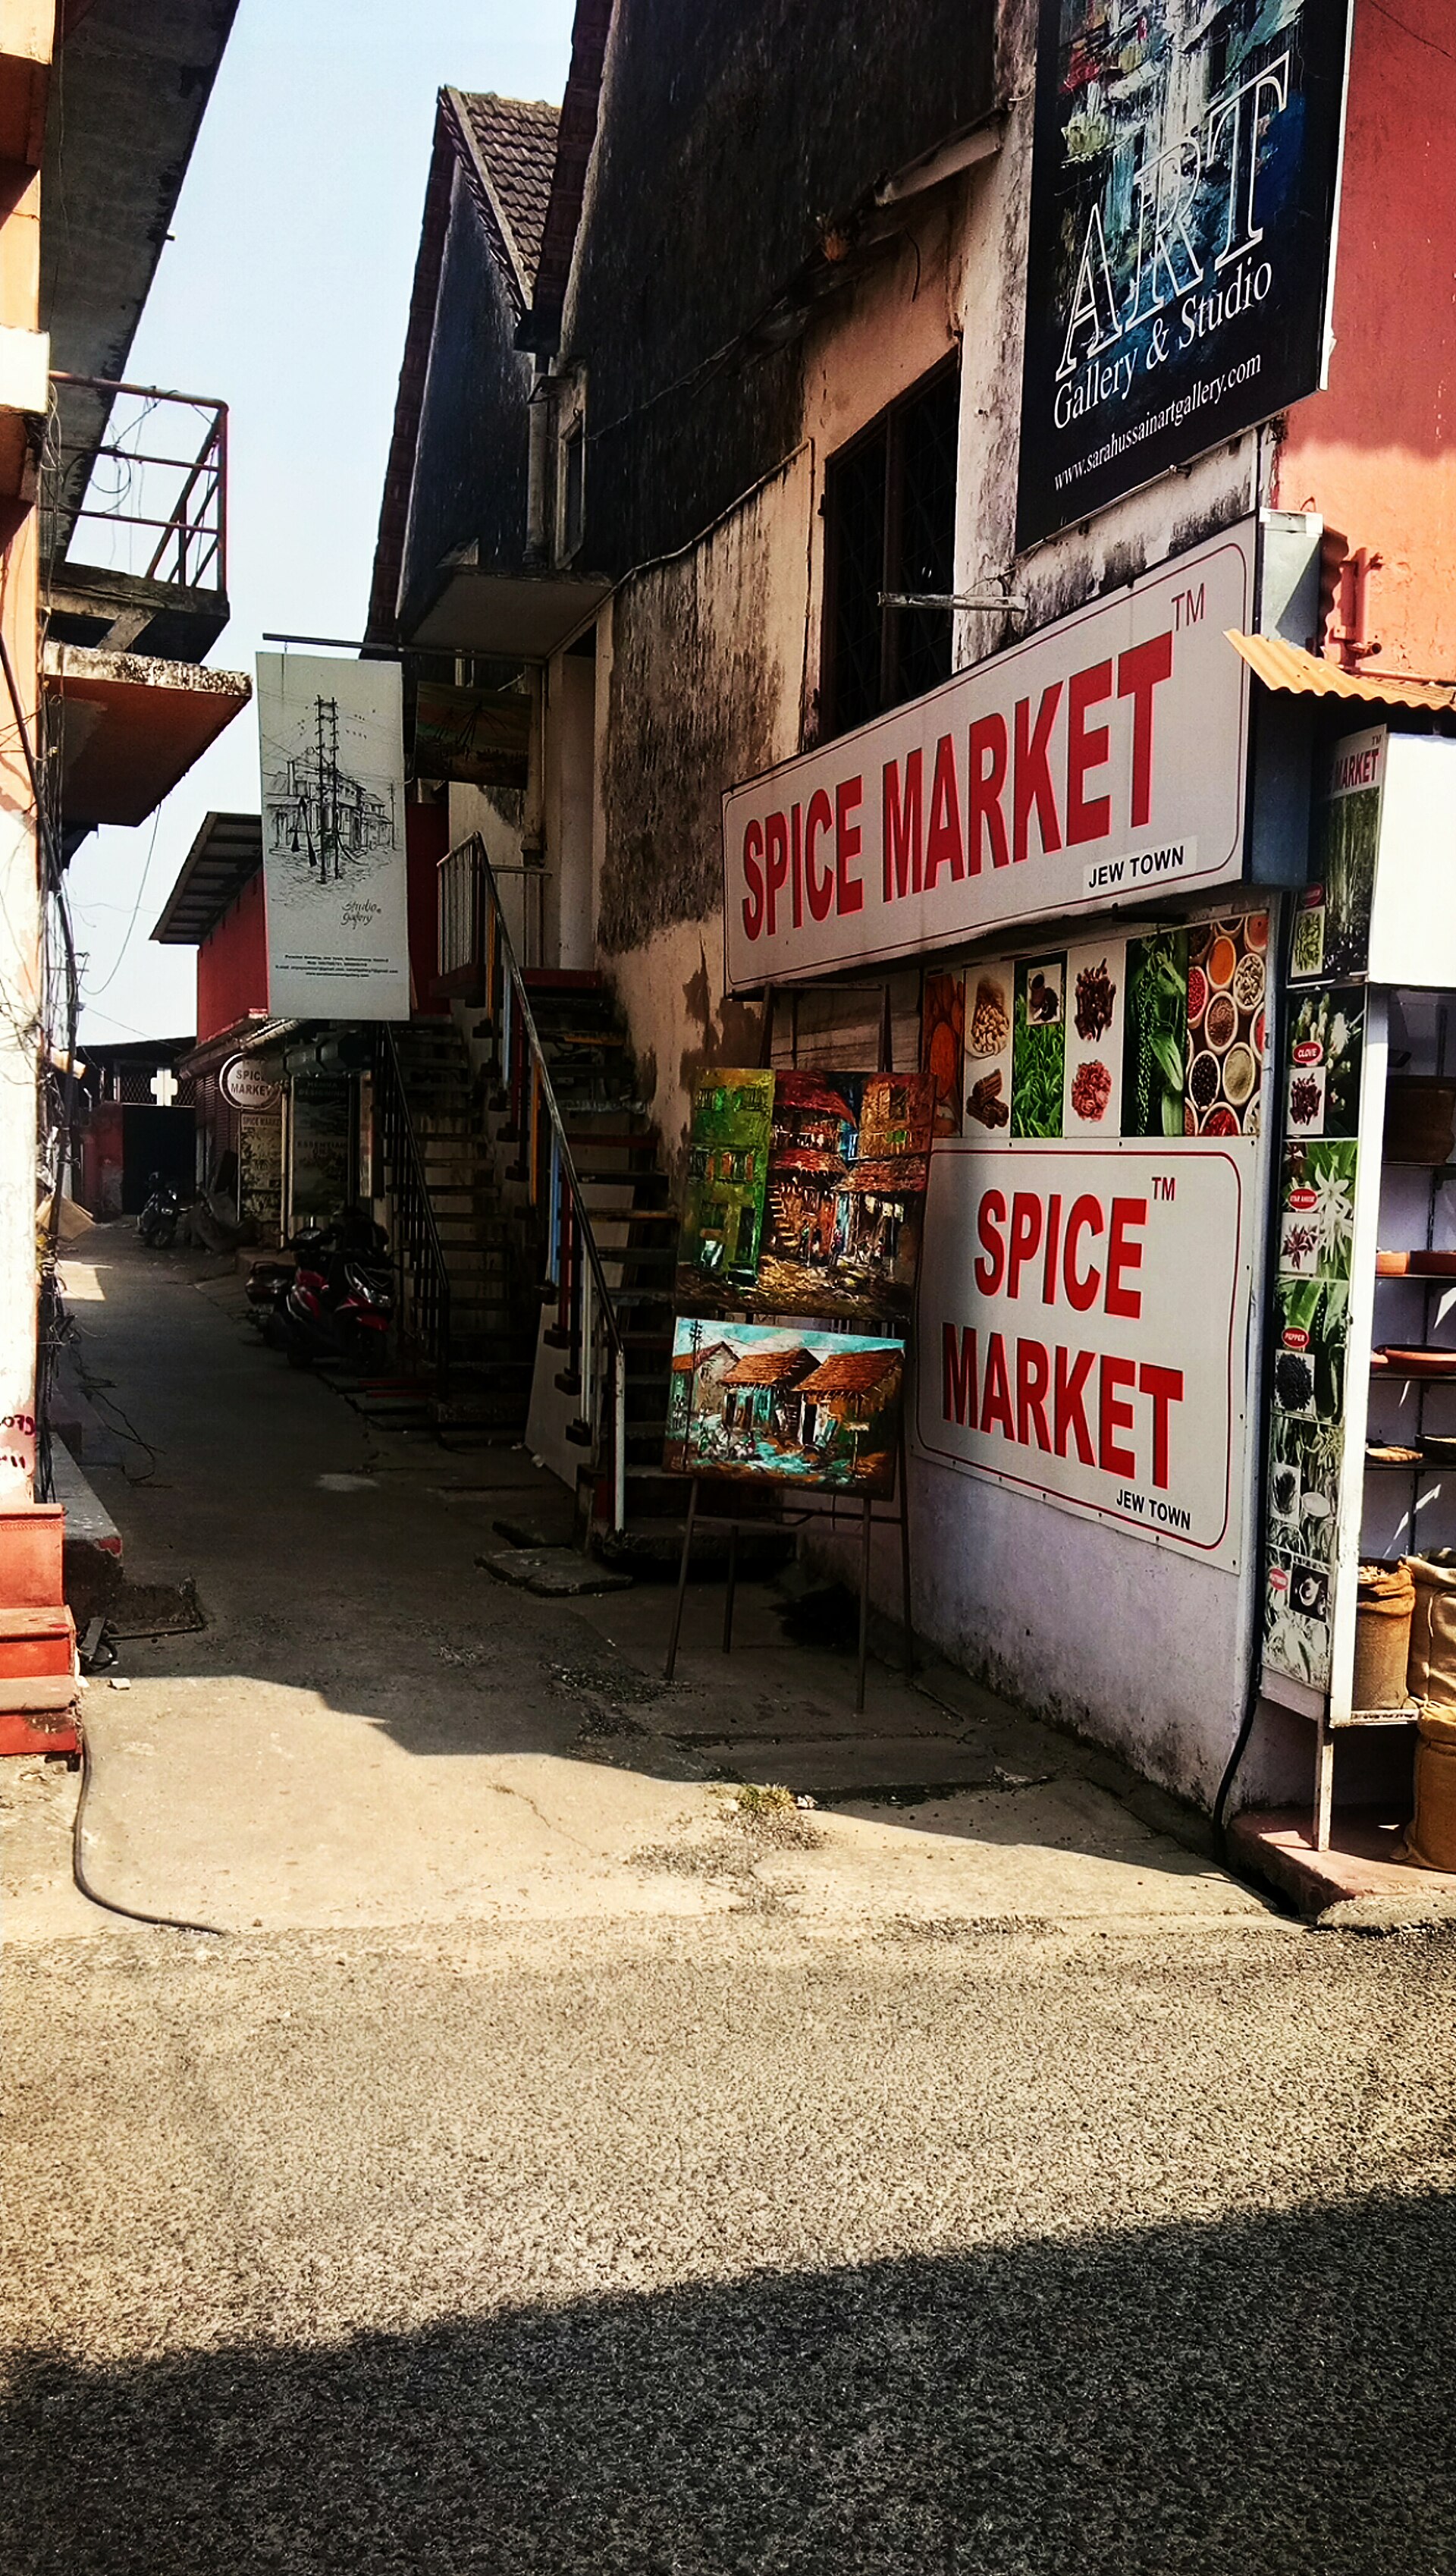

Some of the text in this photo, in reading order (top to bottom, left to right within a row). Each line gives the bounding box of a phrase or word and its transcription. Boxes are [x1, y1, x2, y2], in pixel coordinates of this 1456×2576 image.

[1055, 50, 1289, 382] ART
[1053, 256, 1272, 430] Gallery & Studio
[1053, 350, 1262, 493] www.sarahussainartgallery.com
[1171, 583, 1204, 631] TM
[742, 631, 1172, 942] SPICE MARKET
[1333, 747, 1379, 792] MARKET
[1088, 845, 1185, 888] JEW TOWN
[236, 1069, 265, 1082] SPIC
[1151, 1176, 1175, 1202] TM
[974, 1189, 1148, 1320] SPICE
[942, 1322, 1184, 1491] MARKET
[1116, 1488, 1191, 1531] JEW TOWN
